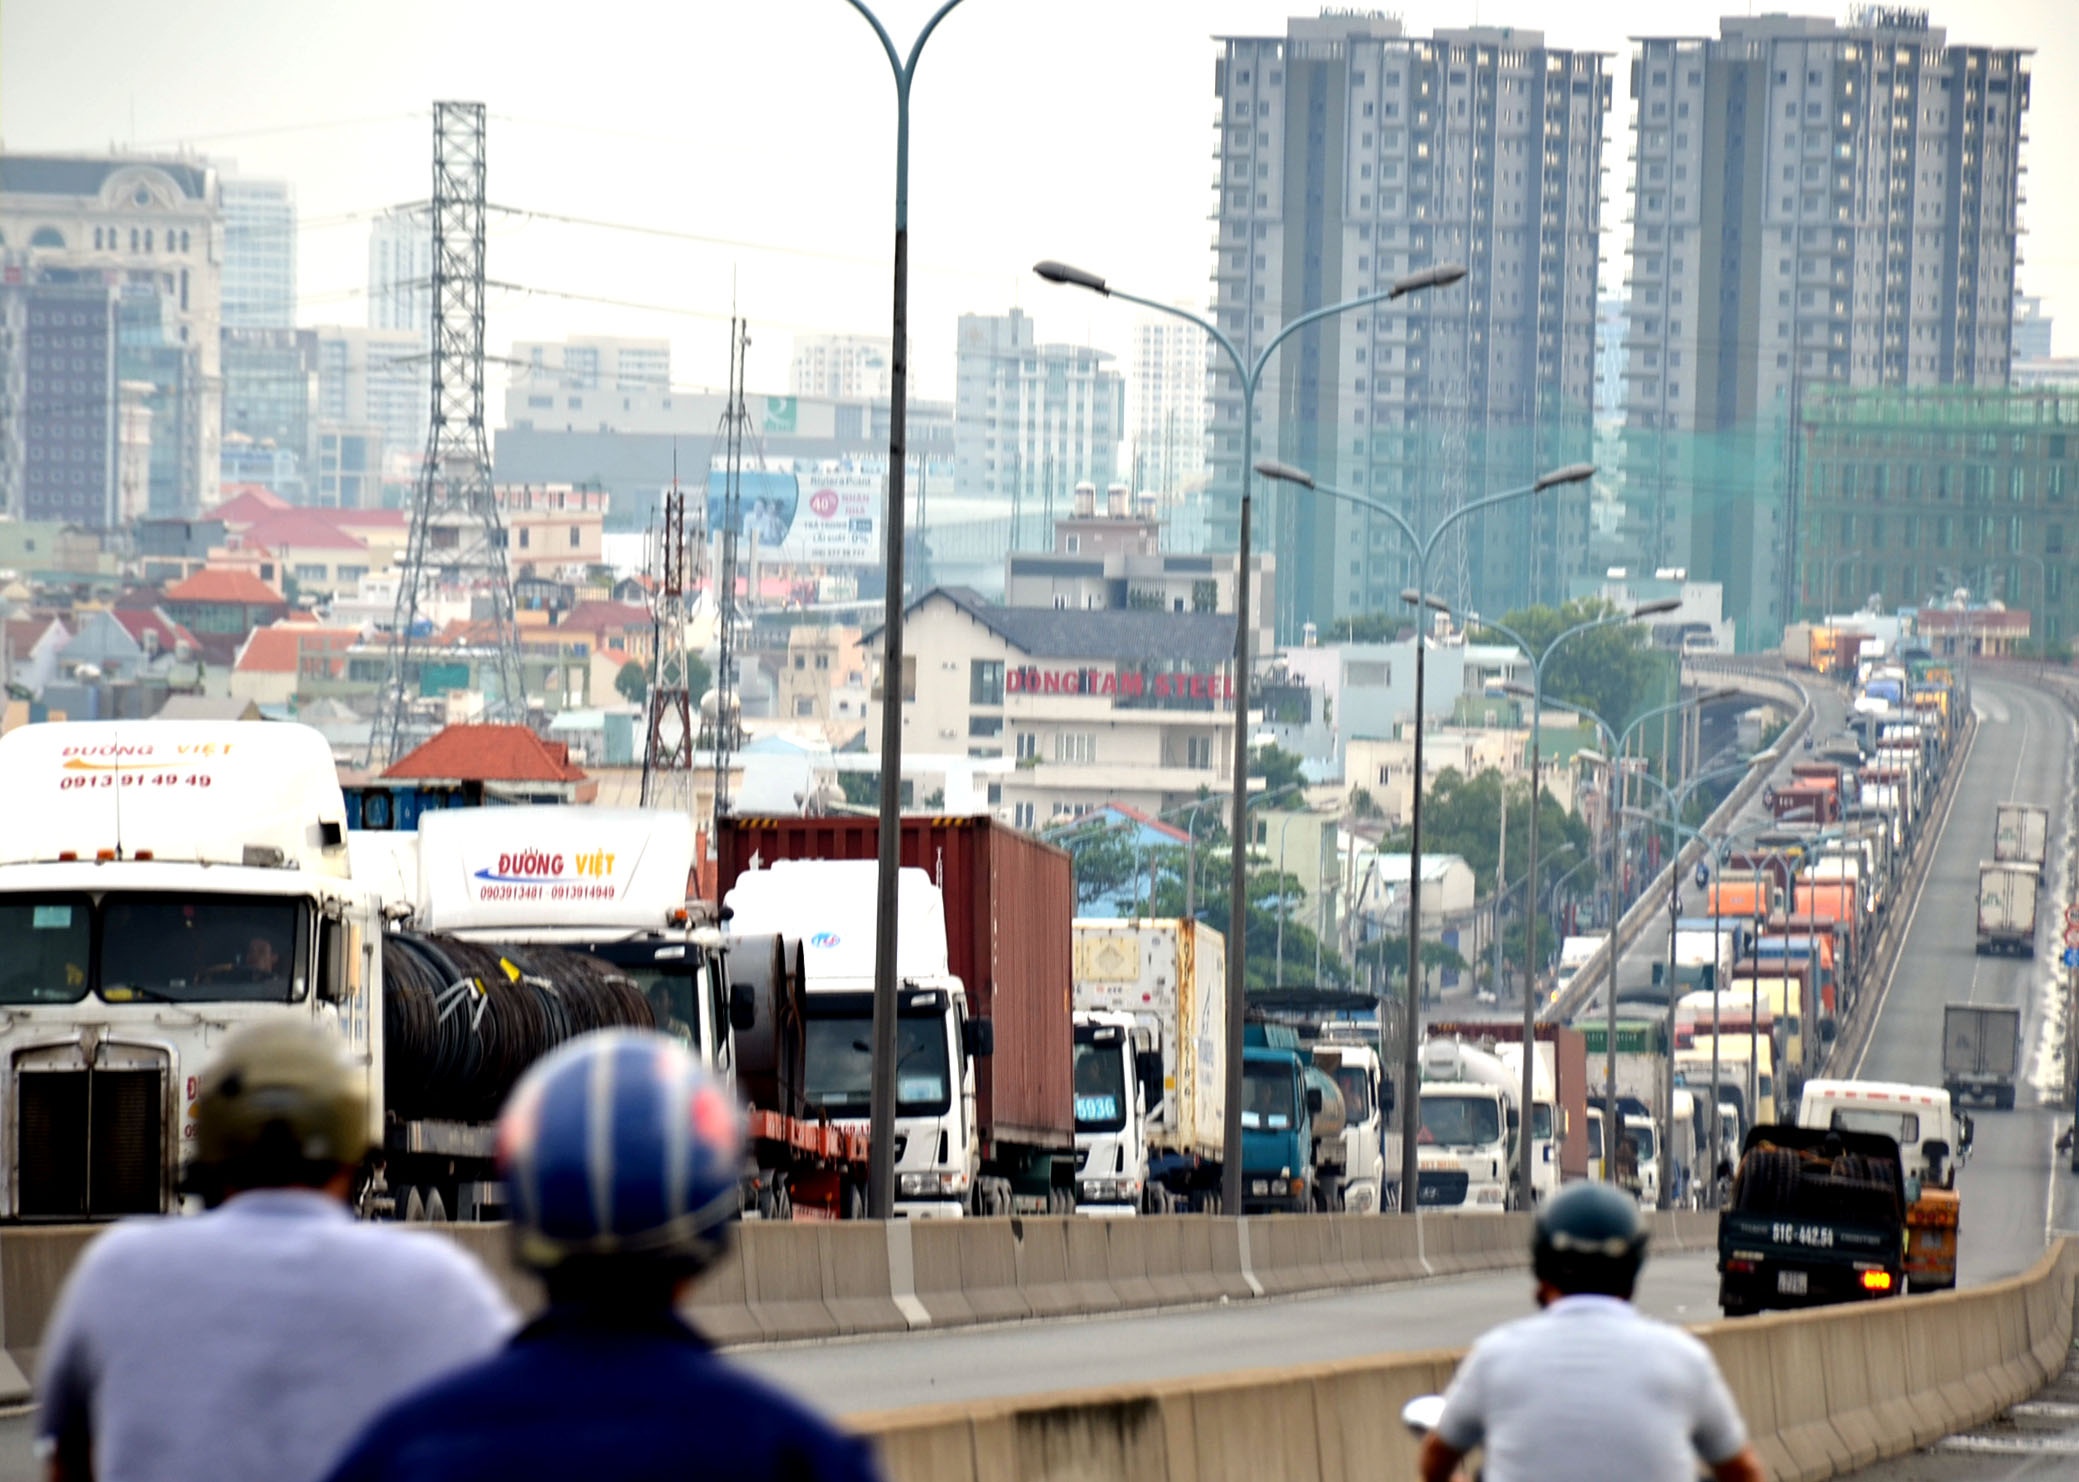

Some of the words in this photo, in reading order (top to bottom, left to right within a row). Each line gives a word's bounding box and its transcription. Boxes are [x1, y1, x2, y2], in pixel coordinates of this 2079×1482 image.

[1154, 672, 1236, 699] STEEL
[60, 774, 112, 790] 0913
[121, 774, 144, 787] 91
[151, 773, 178, 787] 49
[185, 774, 211, 788] 49
[575, 848, 615, 879] VIỆT
